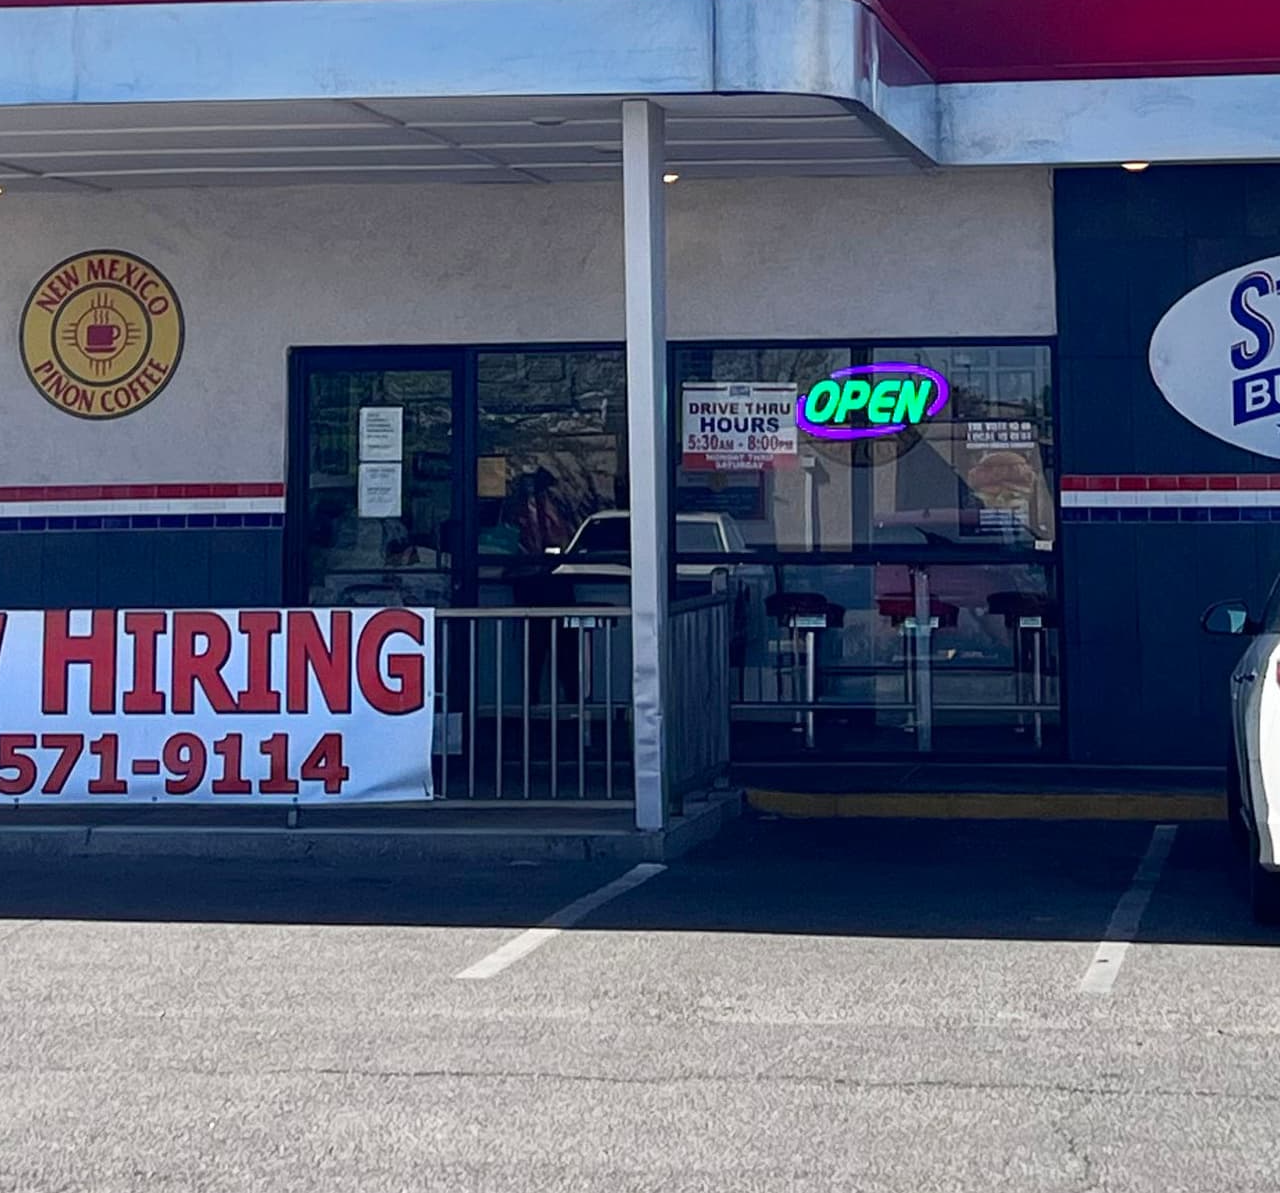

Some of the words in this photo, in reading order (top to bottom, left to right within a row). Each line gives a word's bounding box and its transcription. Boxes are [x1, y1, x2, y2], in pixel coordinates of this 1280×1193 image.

[35, 264, 80, 314] NEW
[87, 258, 169, 316] MEXICO
[100, 358, 169, 412] COFFEE
[689, 402, 739, 415] DRIVE
[745, 402, 791, 415] THRU
[805, 379, 932, 425] OPEN
[700, 417, 780, 433] HOURS
[42, 608, 426, 715] HIRING
